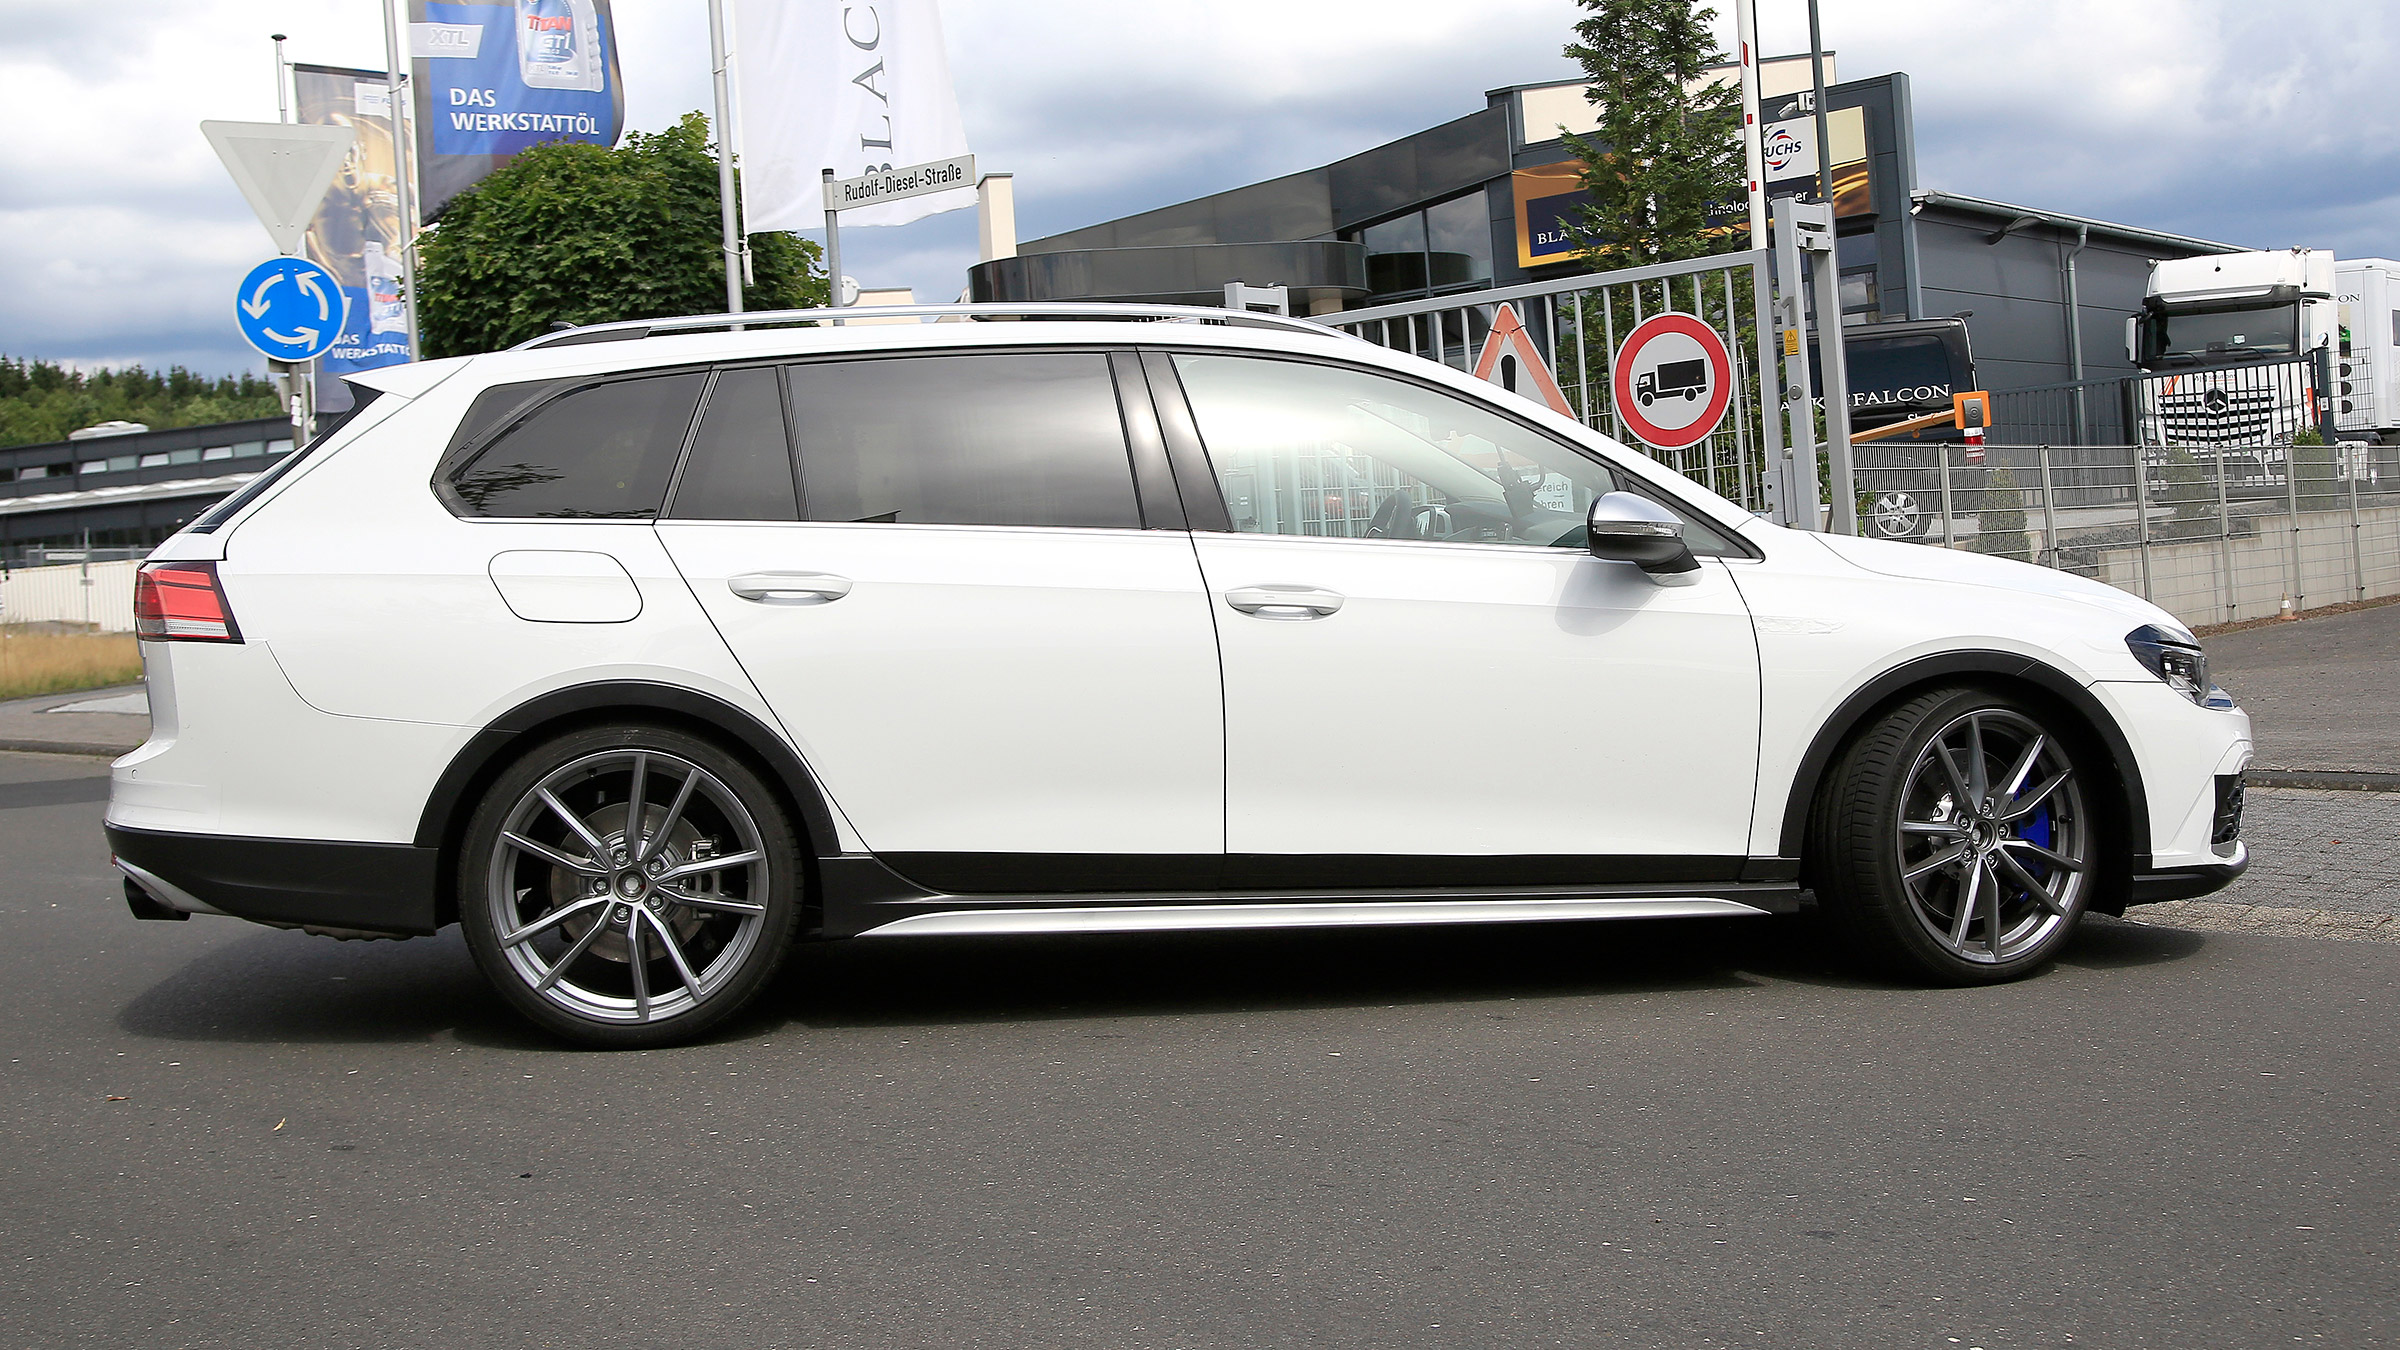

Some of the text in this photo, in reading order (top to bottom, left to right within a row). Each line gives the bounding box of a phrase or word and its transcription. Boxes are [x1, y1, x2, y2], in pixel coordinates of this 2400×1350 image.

[429, 27, 470, 46] XTL
[450, 87, 496, 107] DAS
[450, 112, 600, 135] WERKSTATTÖL
[1764, 140, 1802, 158] UCHS
[844, 163, 962, 202] Rudolf-Diesel-Straße
[1853, 384, 1949, 406] FALCON
